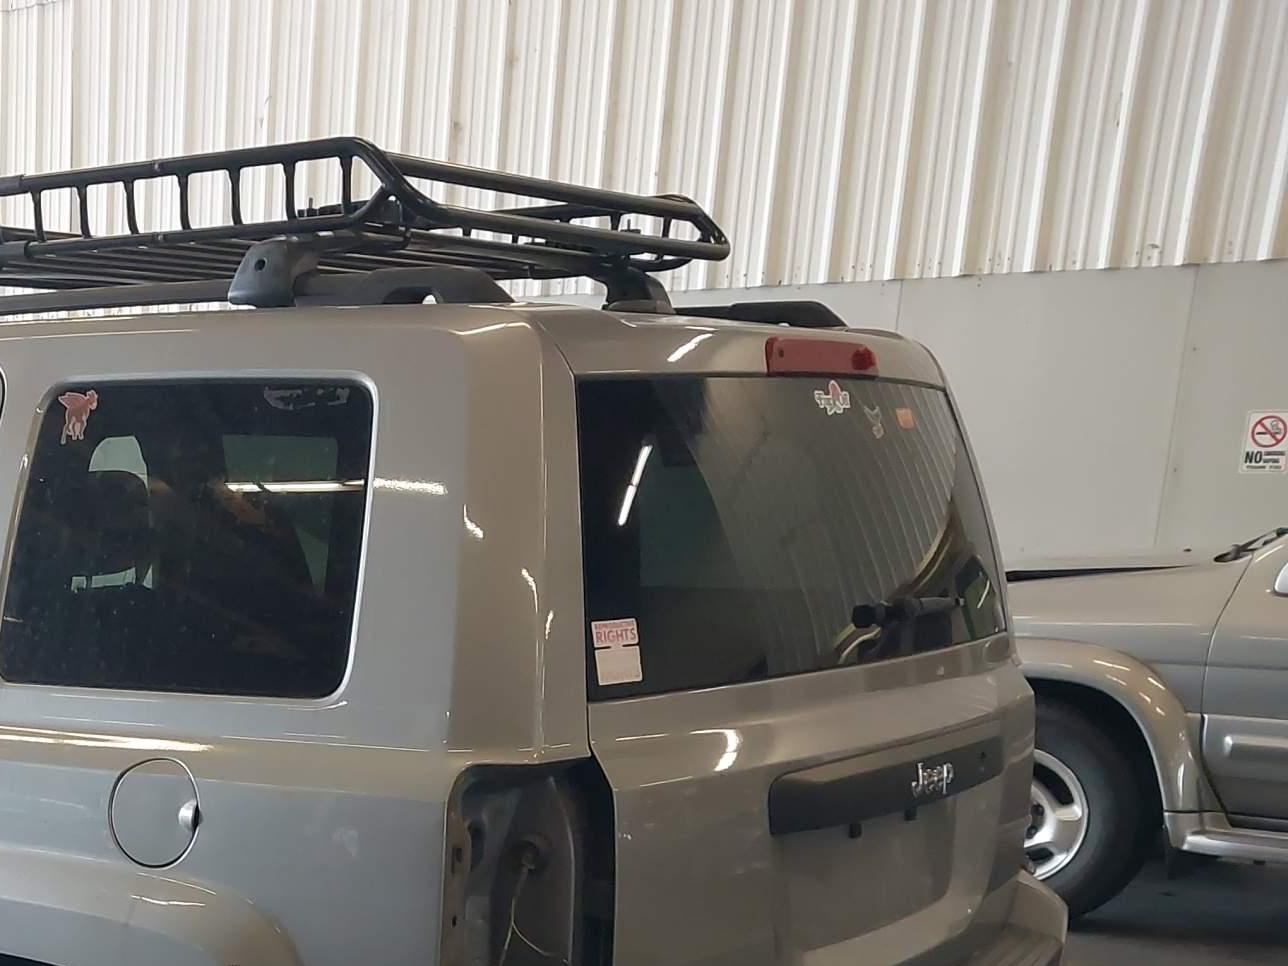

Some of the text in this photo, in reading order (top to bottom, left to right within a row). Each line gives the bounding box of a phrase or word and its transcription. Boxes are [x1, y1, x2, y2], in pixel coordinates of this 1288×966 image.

[1244, 450, 1263, 464] NO
[595, 627, 637, 643] RIGHTS
[911, 762, 954, 798] Jeep
